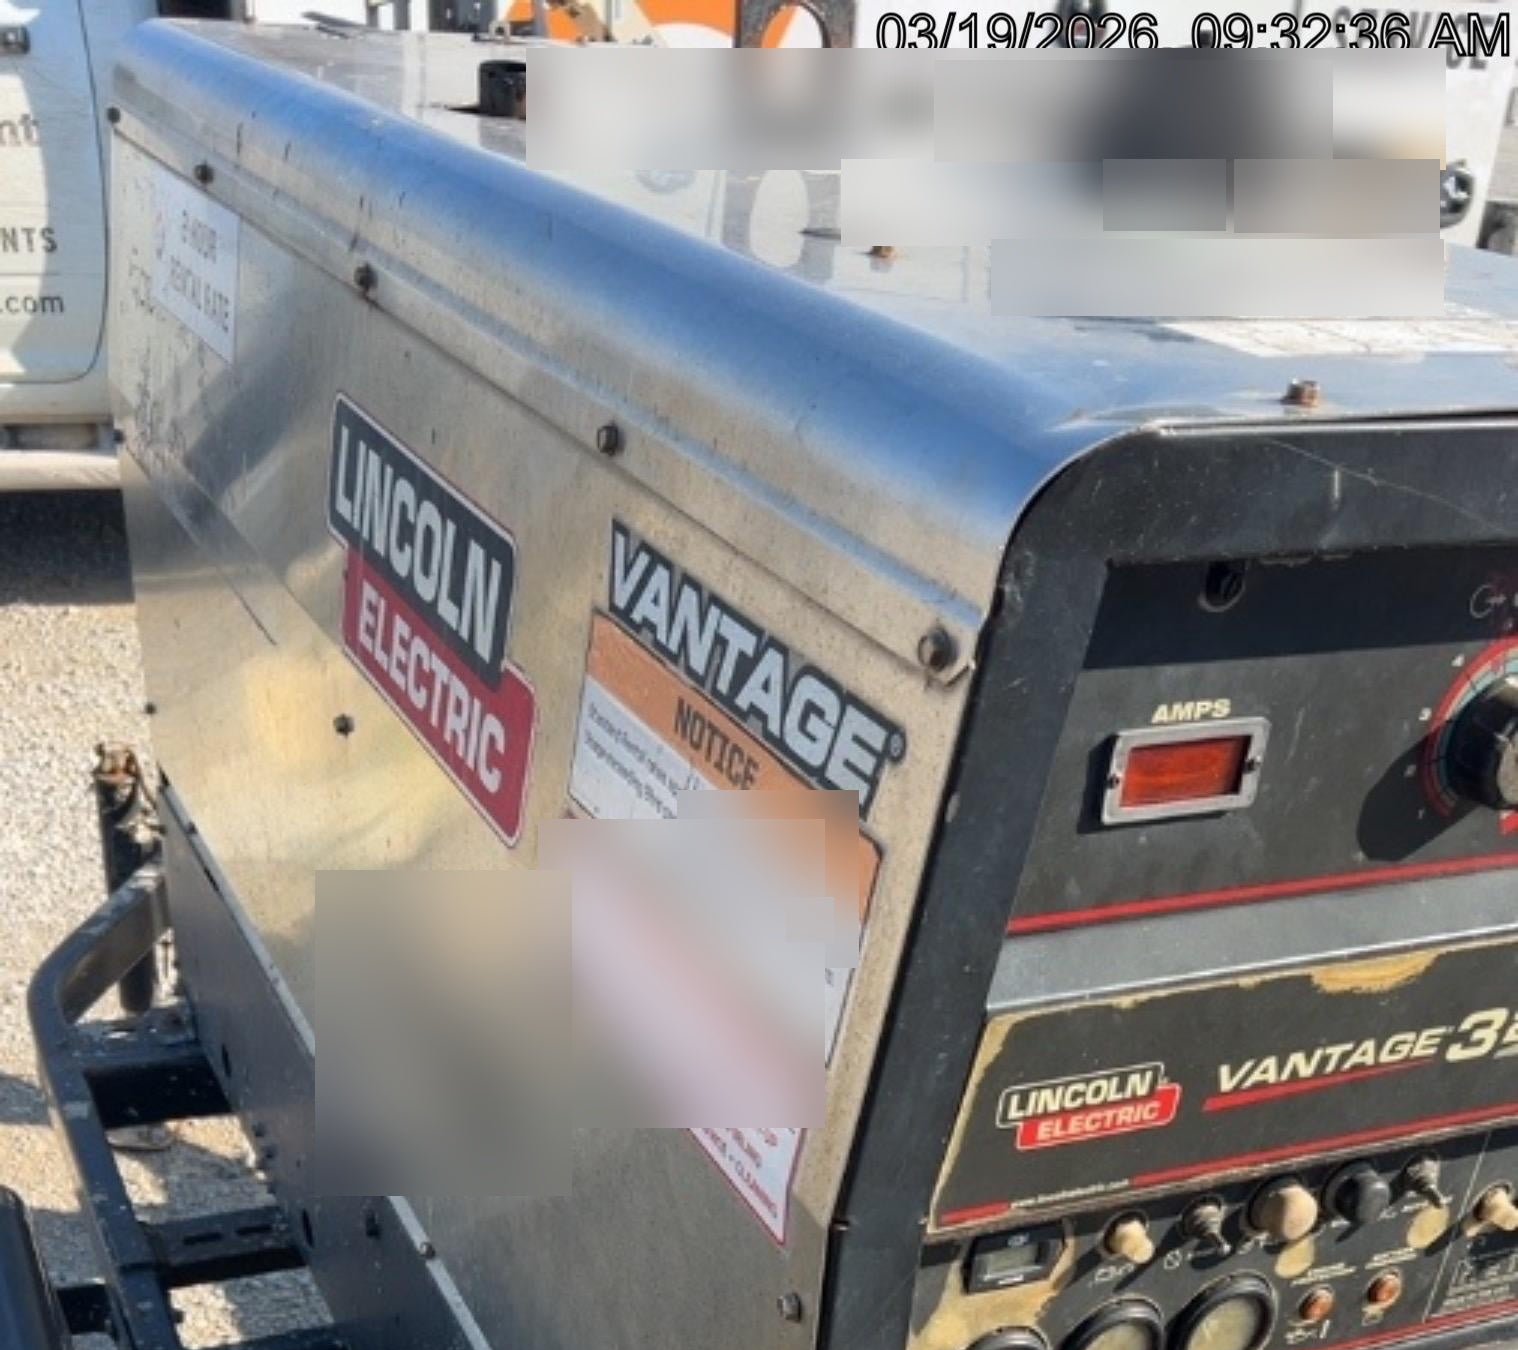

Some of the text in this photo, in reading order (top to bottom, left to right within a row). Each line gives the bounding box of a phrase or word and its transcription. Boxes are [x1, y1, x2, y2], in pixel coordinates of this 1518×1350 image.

[0, 226, 58, 253] NTS
[334, 424, 503, 665] LINCOLN
[358, 578, 506, 795] ELECTRIC
[611, 525, 890, 810] VANTAGE
[673, 695, 761, 790] NOTICE
[1151, 698, 1232, 724] AMPS
[1217, 1025, 1449, 1093] VANTAGE
[1007, 1070, 1154, 1121] LINCOLN
[1035, 1101, 1162, 1142] ELECTRIC
